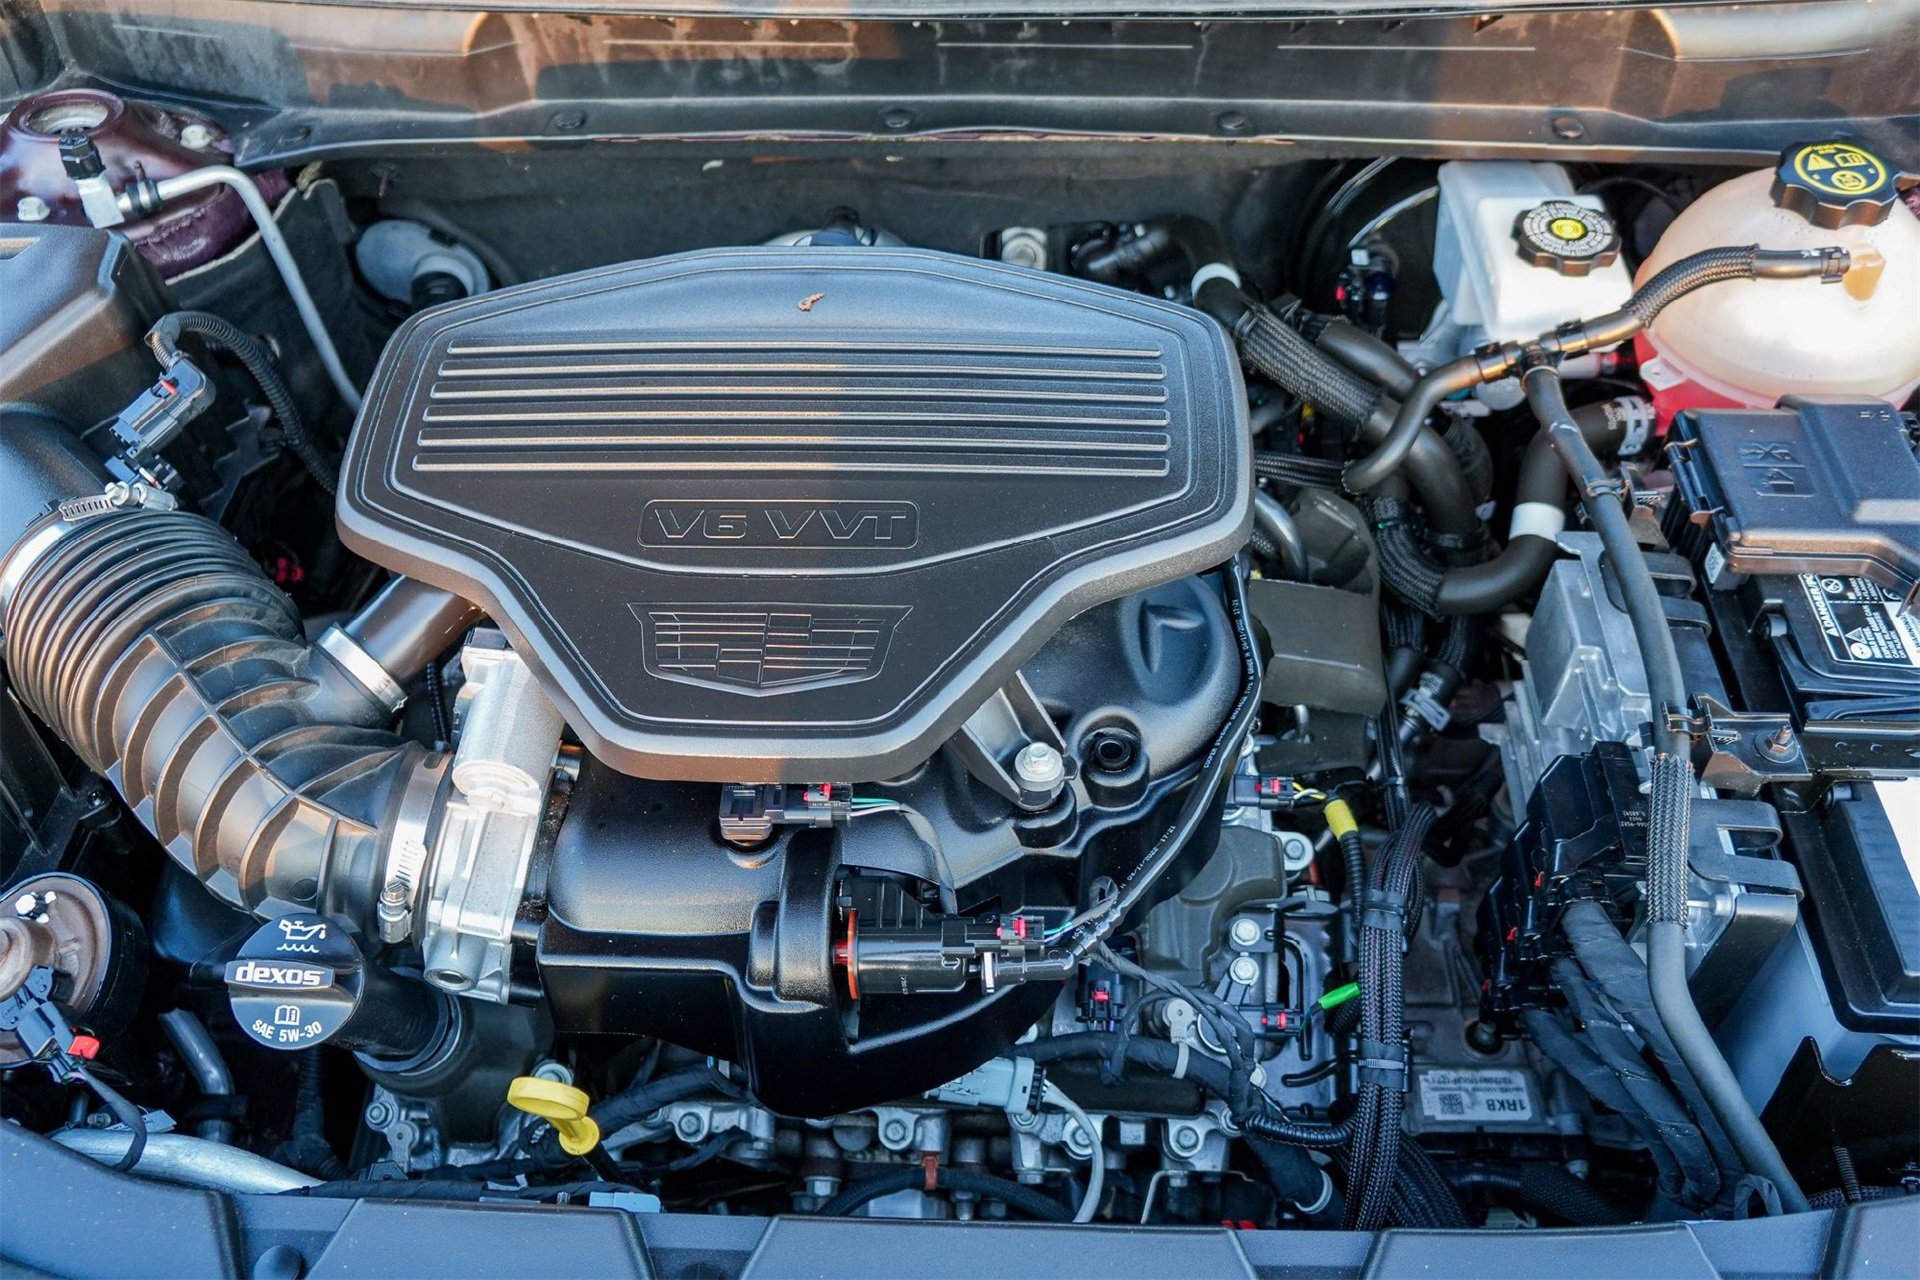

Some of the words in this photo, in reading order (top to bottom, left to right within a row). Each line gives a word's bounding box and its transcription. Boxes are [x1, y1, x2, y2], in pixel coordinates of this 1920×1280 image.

[654, 509, 748, 538] V6
[764, 509, 907, 540] VVT
[235, 962, 324, 986] dexos
[252, 1019, 276, 1040] SAE
[278, 1021, 323, 1042] 5W-30
[1486, 1099, 1527, 1112] 1RKB
